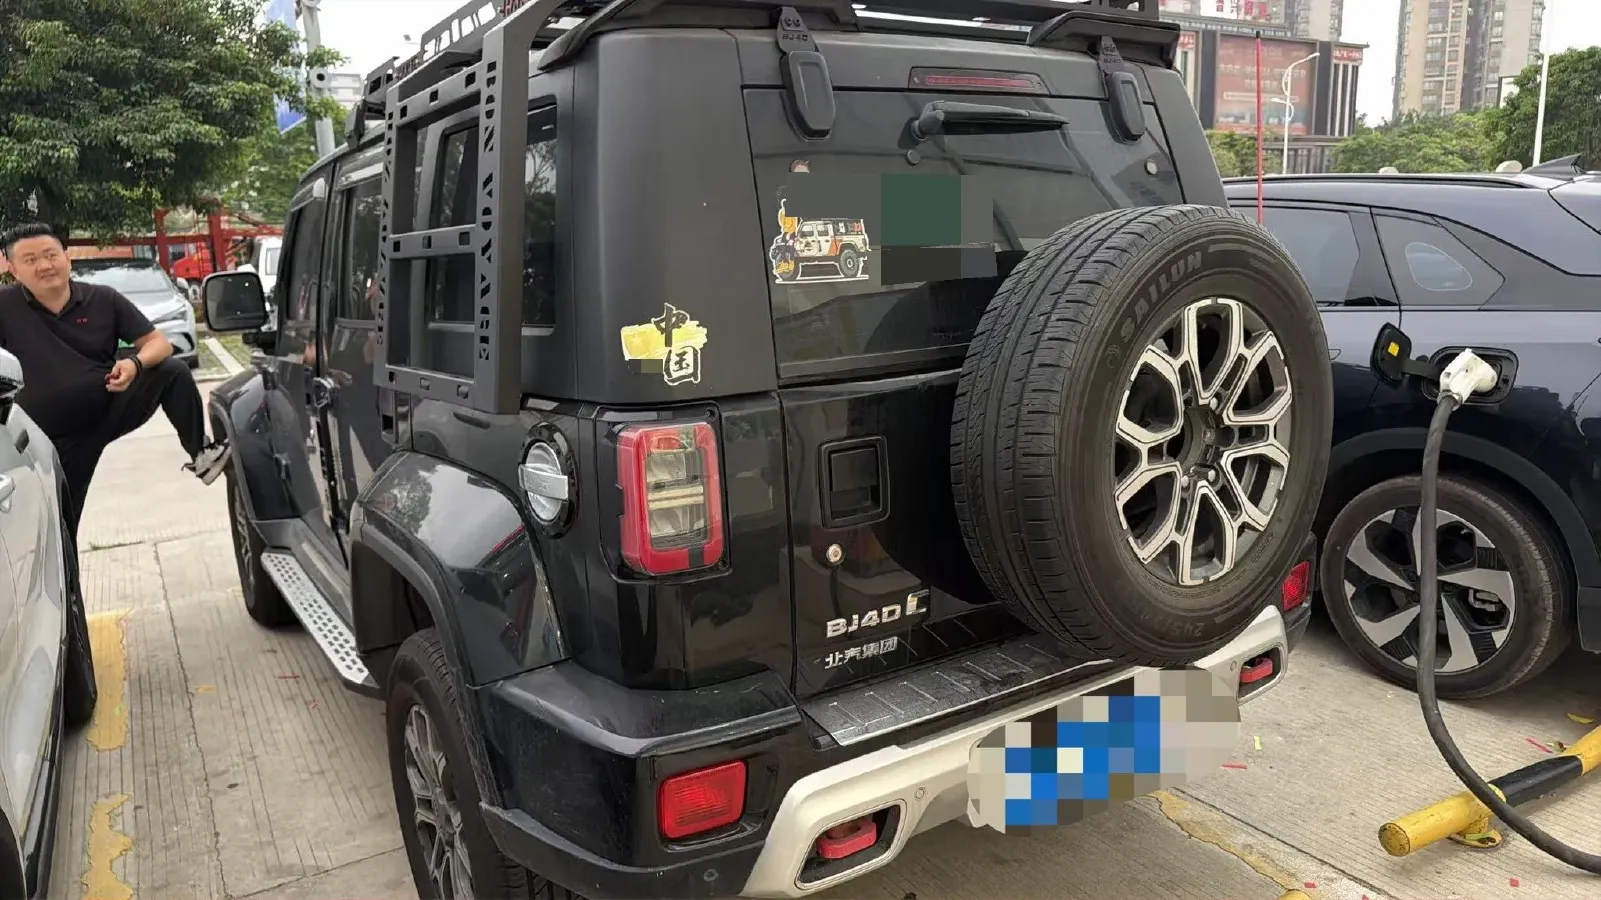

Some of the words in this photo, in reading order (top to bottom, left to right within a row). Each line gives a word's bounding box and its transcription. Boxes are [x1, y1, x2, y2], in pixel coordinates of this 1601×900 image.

[1121, 251, 1202, 342] SAILUN
[652, 303, 700, 385] 中国
[824, 636, 898, 670] 北汽集团
